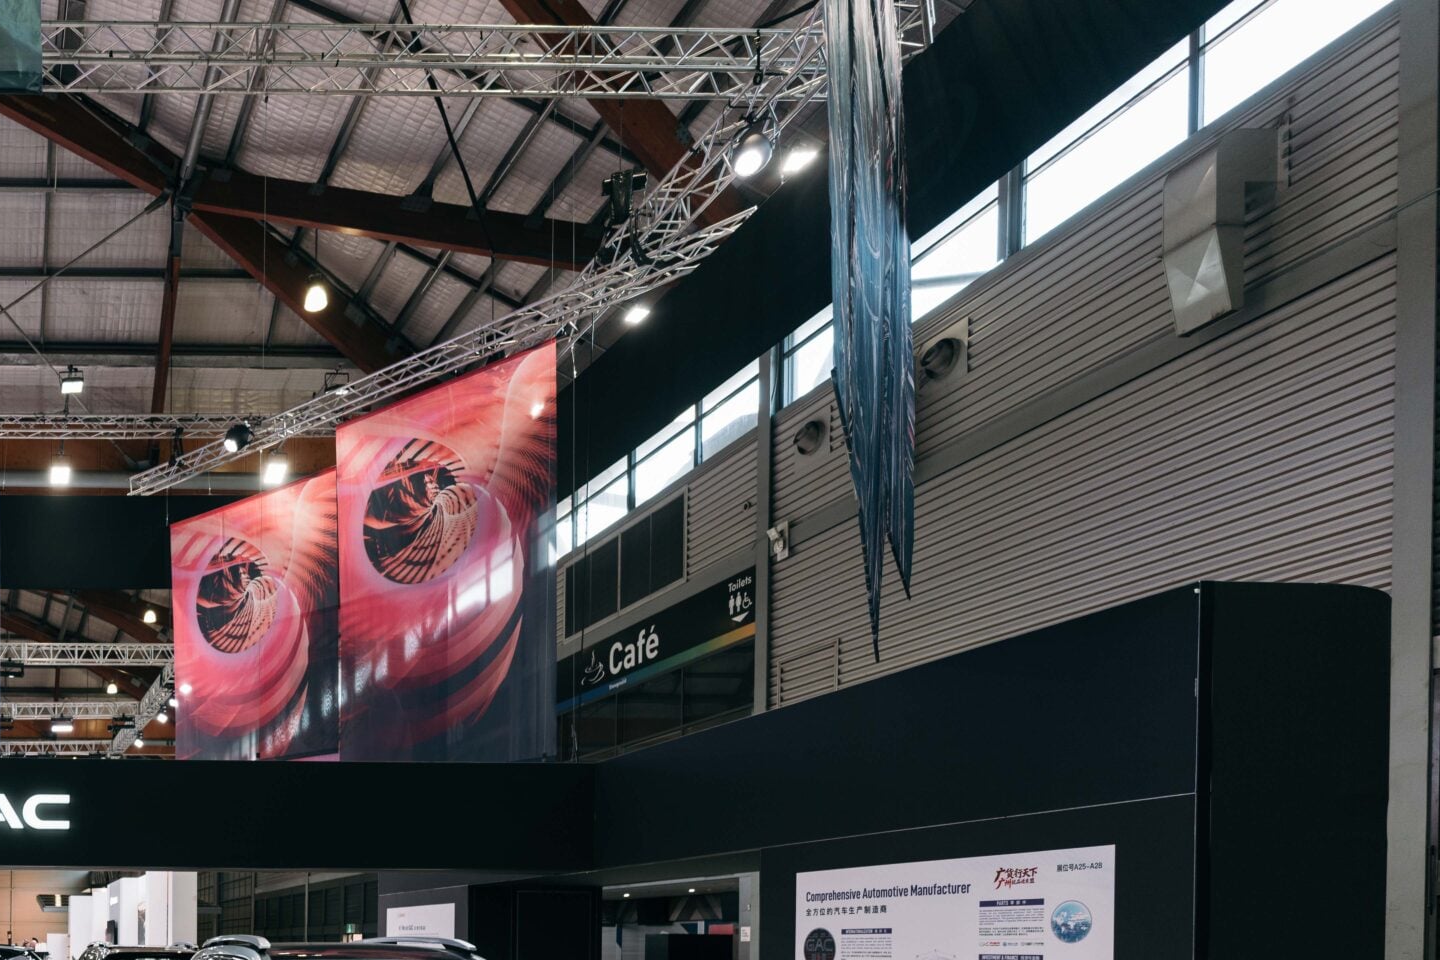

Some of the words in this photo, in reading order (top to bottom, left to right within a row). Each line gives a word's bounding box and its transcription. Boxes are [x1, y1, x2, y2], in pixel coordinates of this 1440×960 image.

[728, 576, 752, 592] Toilets
[609, 624, 659, 674] Café
[806, 888, 860, 903] Comprehensive
[862, 886, 908, 899] Automotive
[910, 883, 971, 896] Manufacturer
